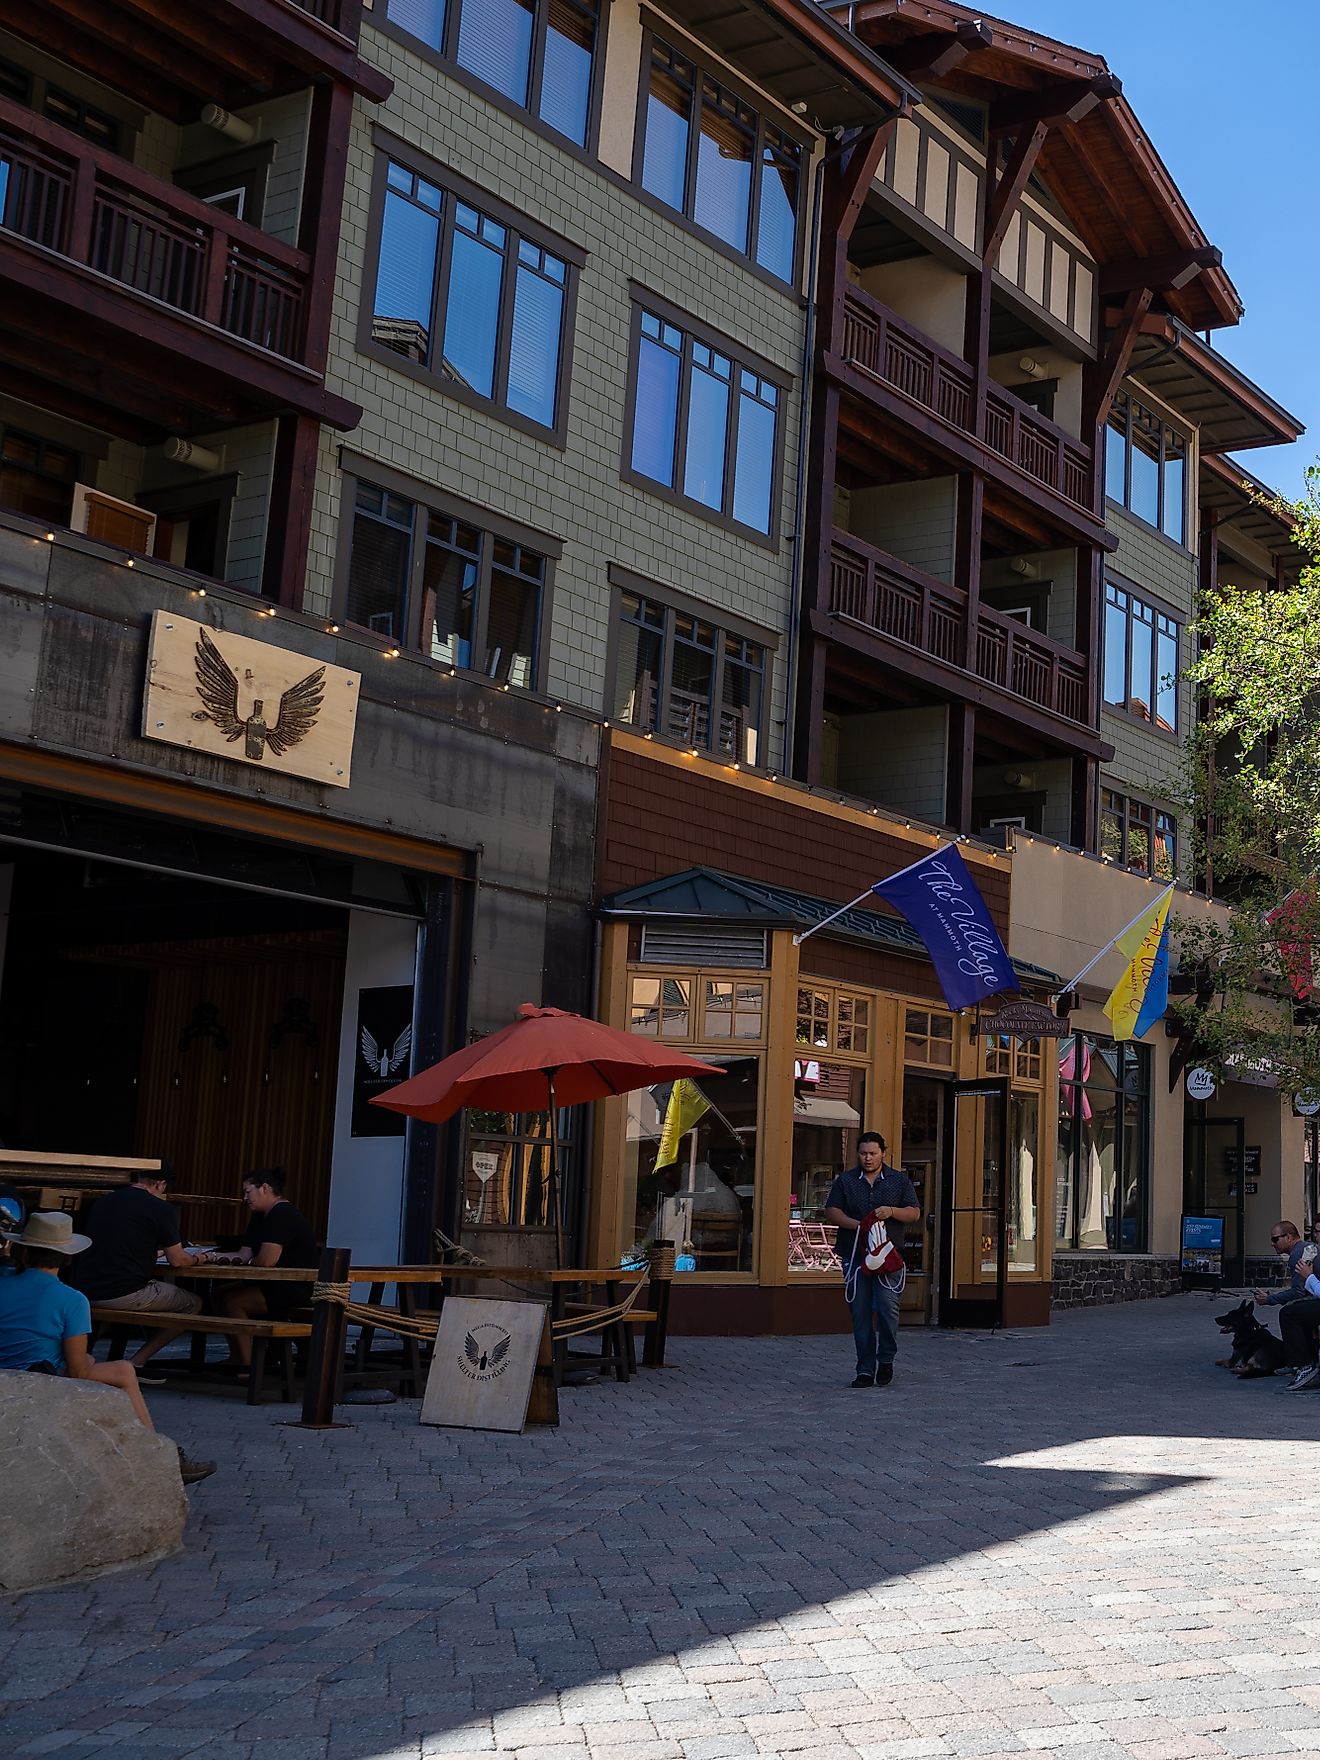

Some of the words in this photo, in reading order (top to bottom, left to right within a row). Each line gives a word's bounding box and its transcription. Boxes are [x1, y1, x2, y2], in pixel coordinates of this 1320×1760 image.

[918, 860, 963, 902] The
[950, 897, 999, 987] Village
[928, 902, 940, 912] AT
[936, 912, 963, 952] MAMMOTH
[985, 1019, 1031, 1031] CHOCOLATE
[1031, 1020, 1066, 1033] FACTORY
[457, 1355, 477, 1380] SHELTER
[476, 1359, 511, 1381] DISTILLING
